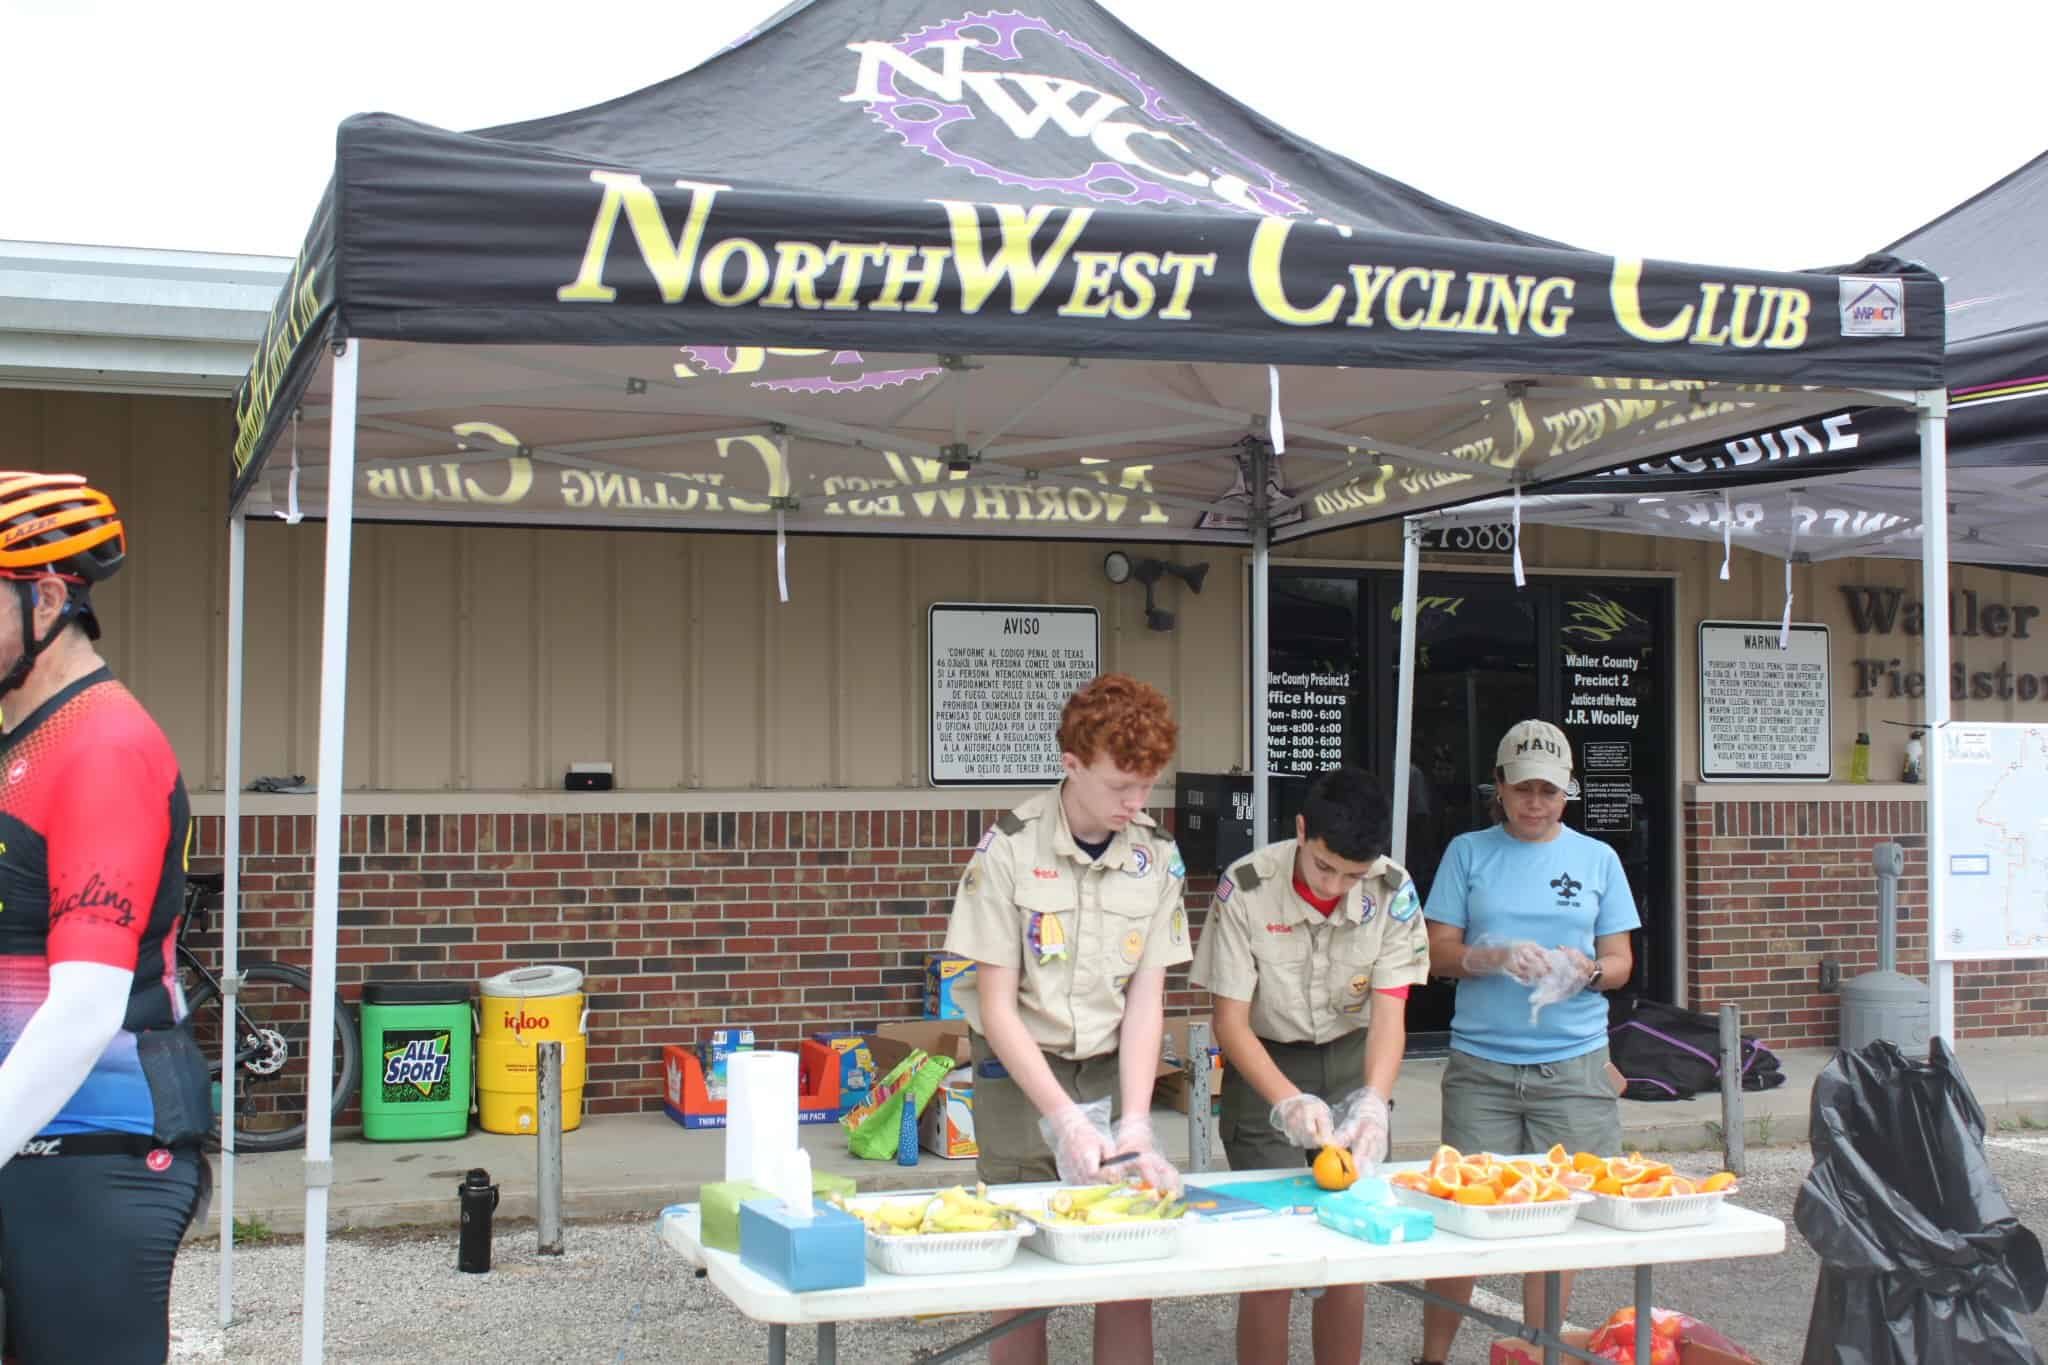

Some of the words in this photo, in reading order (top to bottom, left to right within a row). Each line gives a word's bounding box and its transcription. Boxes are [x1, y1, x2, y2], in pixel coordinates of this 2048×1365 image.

[1248, 216, 1577, 338] CYCLING
[1610, 255, 1812, 350] CLUB
[1003, 617, 1040, 635] AVISO
[1743, 635, 1780, 648] WARNIN
[1565, 654, 1600, 667] Waller
[1602, 655, 1639, 671] County
[1282, 672, 1310, 688] County
[1311, 672, 1343, 686] Precinct
[1344, 673, 1350, 687] 2
[1574, 674, 1619, 687] Precinct
[1622, 674, 1629, 687] 2
[1851, 657, 2048, 701] Fiedsto
[1269, 690, 1302, 704] ffice
[1304, 691, 1346, 705] Hours
[1571, 692, 1596, 705] Justice
[1597, 693, 1604, 705] of
[1604, 694, 1615, 706] the
[1616, 694, 1637, 707] Peace
[1291, 709, 1313, 719] 8:00
[1320, 709, 1342, 720] 6:00
[1565, 709, 1589, 724] J.R.
[1590, 710, 1640, 729] Woolley
[1292, 722, 1314, 733] 8:00
[1320, 723, 1342, 733] 6:00
[1292, 736, 1314, 746] 8:00
[1320, 736, 1342, 746] 6:00
[1516, 738, 1561, 759] MAUI
[1292, 748, 1314, 758] 8:00
[1320, 749, 1342, 759] 6:00
[1291, 761, 1313, 771] 8:00
[504, 1011, 550, 1034] igloo
[402, 1040, 436, 1063] ALL
[384, 1056, 449, 1084] SPORT
